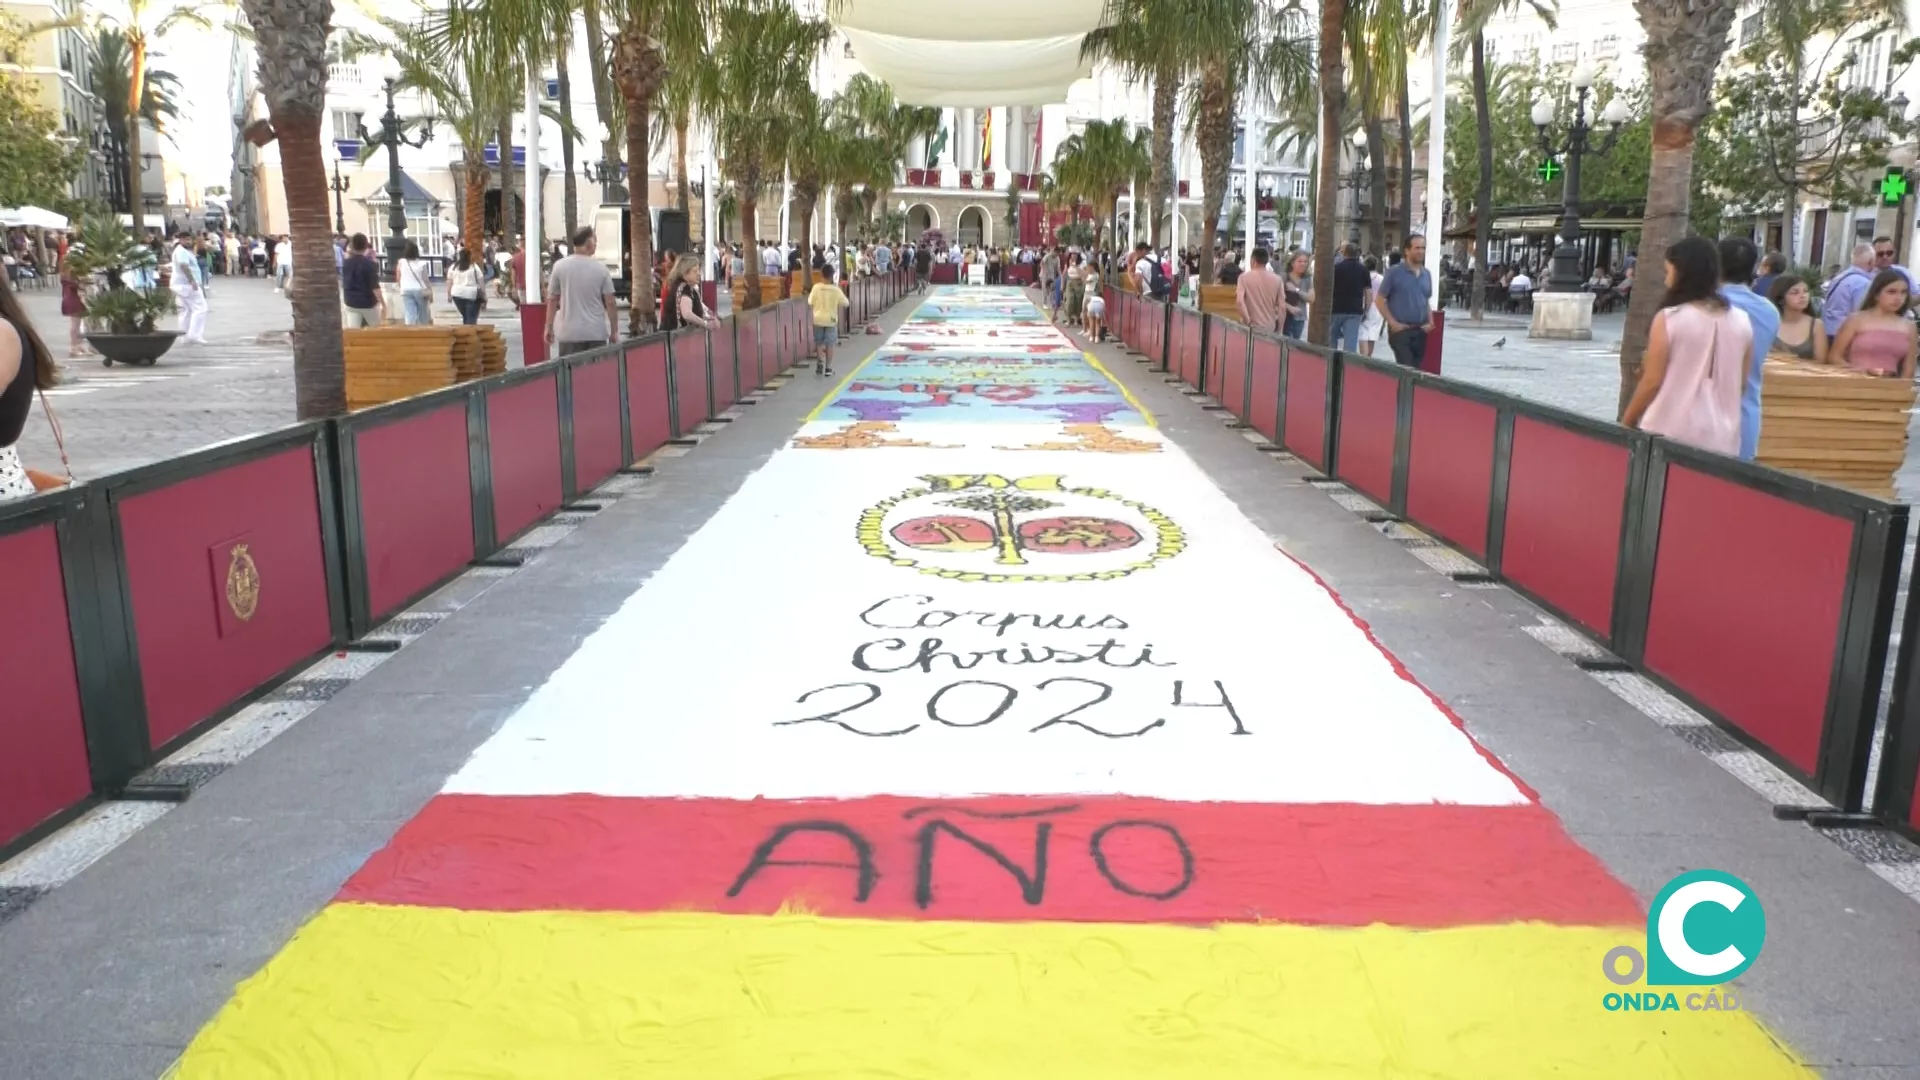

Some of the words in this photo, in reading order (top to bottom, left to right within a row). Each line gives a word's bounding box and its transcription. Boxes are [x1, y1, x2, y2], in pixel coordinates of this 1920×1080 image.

[859, 595, 1129, 637] Corpus
[852, 637, 1178, 673] Christi
[772, 676, 1253, 738] 2024
[726, 804, 1194, 910] AÑO
